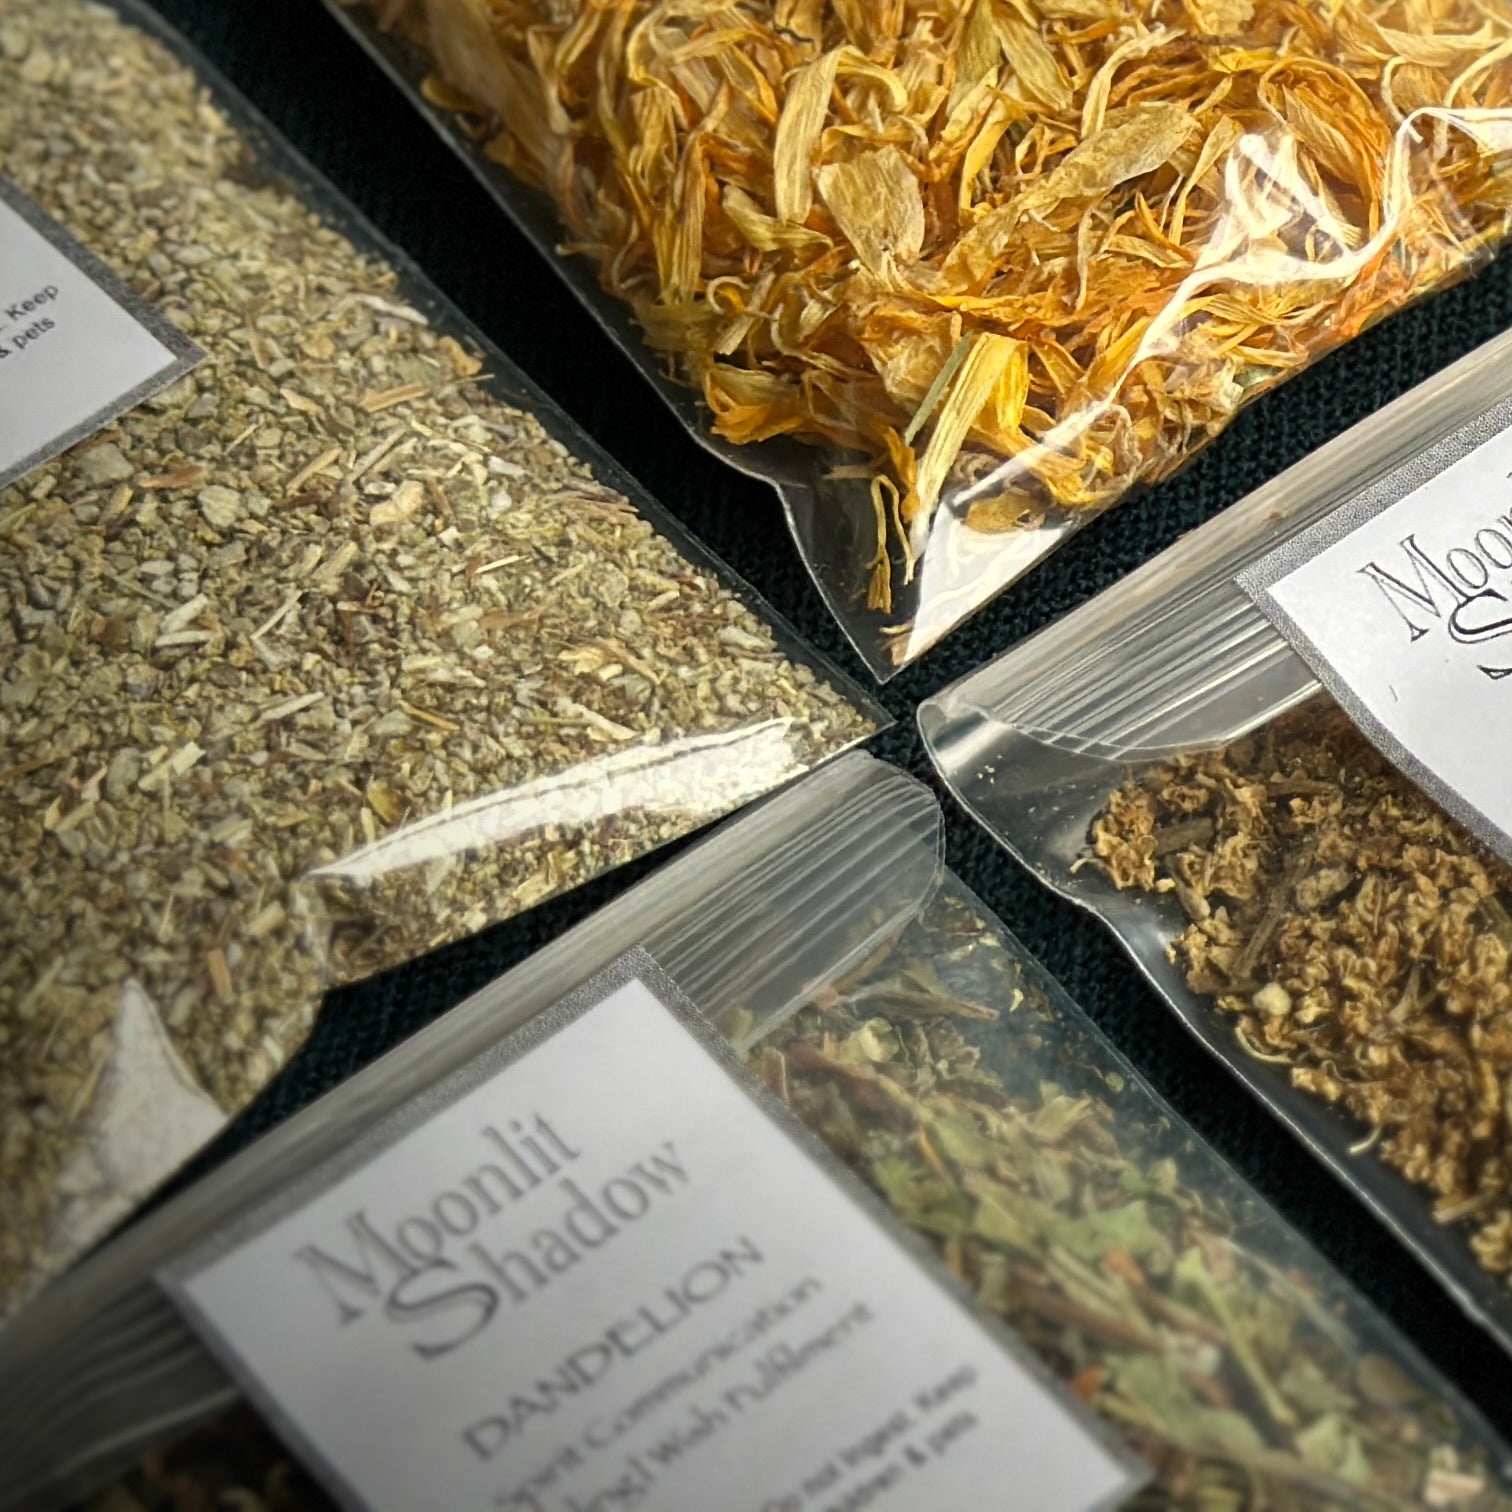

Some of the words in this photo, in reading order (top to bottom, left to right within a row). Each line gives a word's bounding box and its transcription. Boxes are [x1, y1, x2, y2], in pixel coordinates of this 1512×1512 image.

[4, 284, 60, 321] Keep
[14, 317, 56, 350] pets
[291, 1112, 582, 1328] Moonlit
[383, 1141, 689, 1362] Shadow
[461, 1236, 764, 1462] DANDELION
